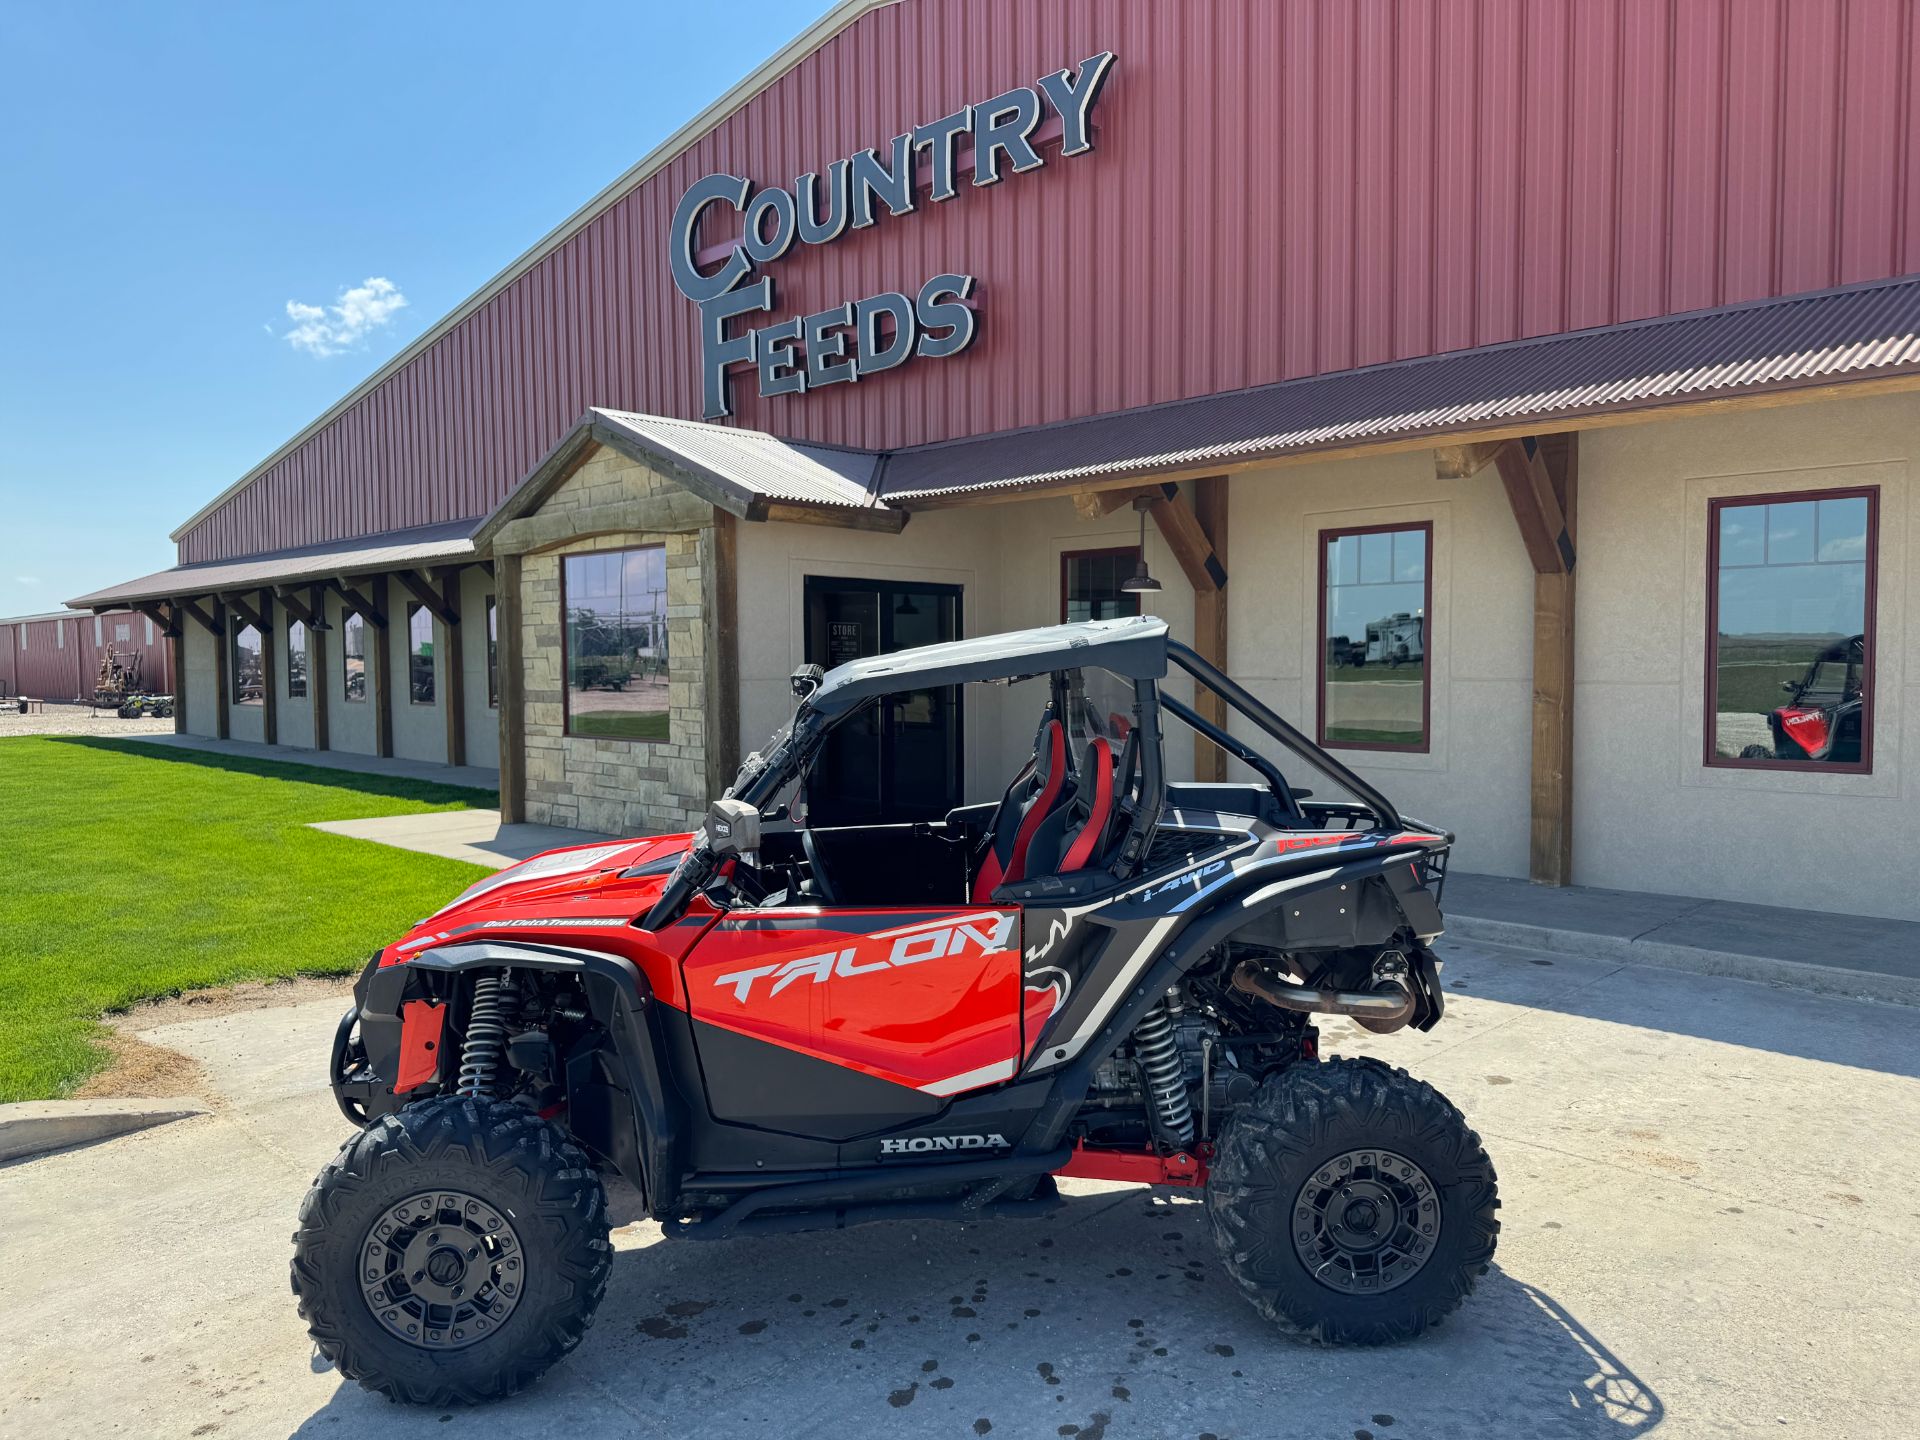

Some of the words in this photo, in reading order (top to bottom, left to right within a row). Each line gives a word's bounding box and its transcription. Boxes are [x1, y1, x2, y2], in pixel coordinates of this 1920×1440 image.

[669, 51, 1117, 302] COUNTRY
[699, 273, 976, 419] FEEDS
[832, 624, 857, 636] STORE
[483, 919, 512, 928] Dual
[510, 919, 549, 927] Clutch
[549, 918, 626, 926] Transmission
[713, 915, 1015, 1004] TALON
[880, 1133, 1011, 1154] HONDA
